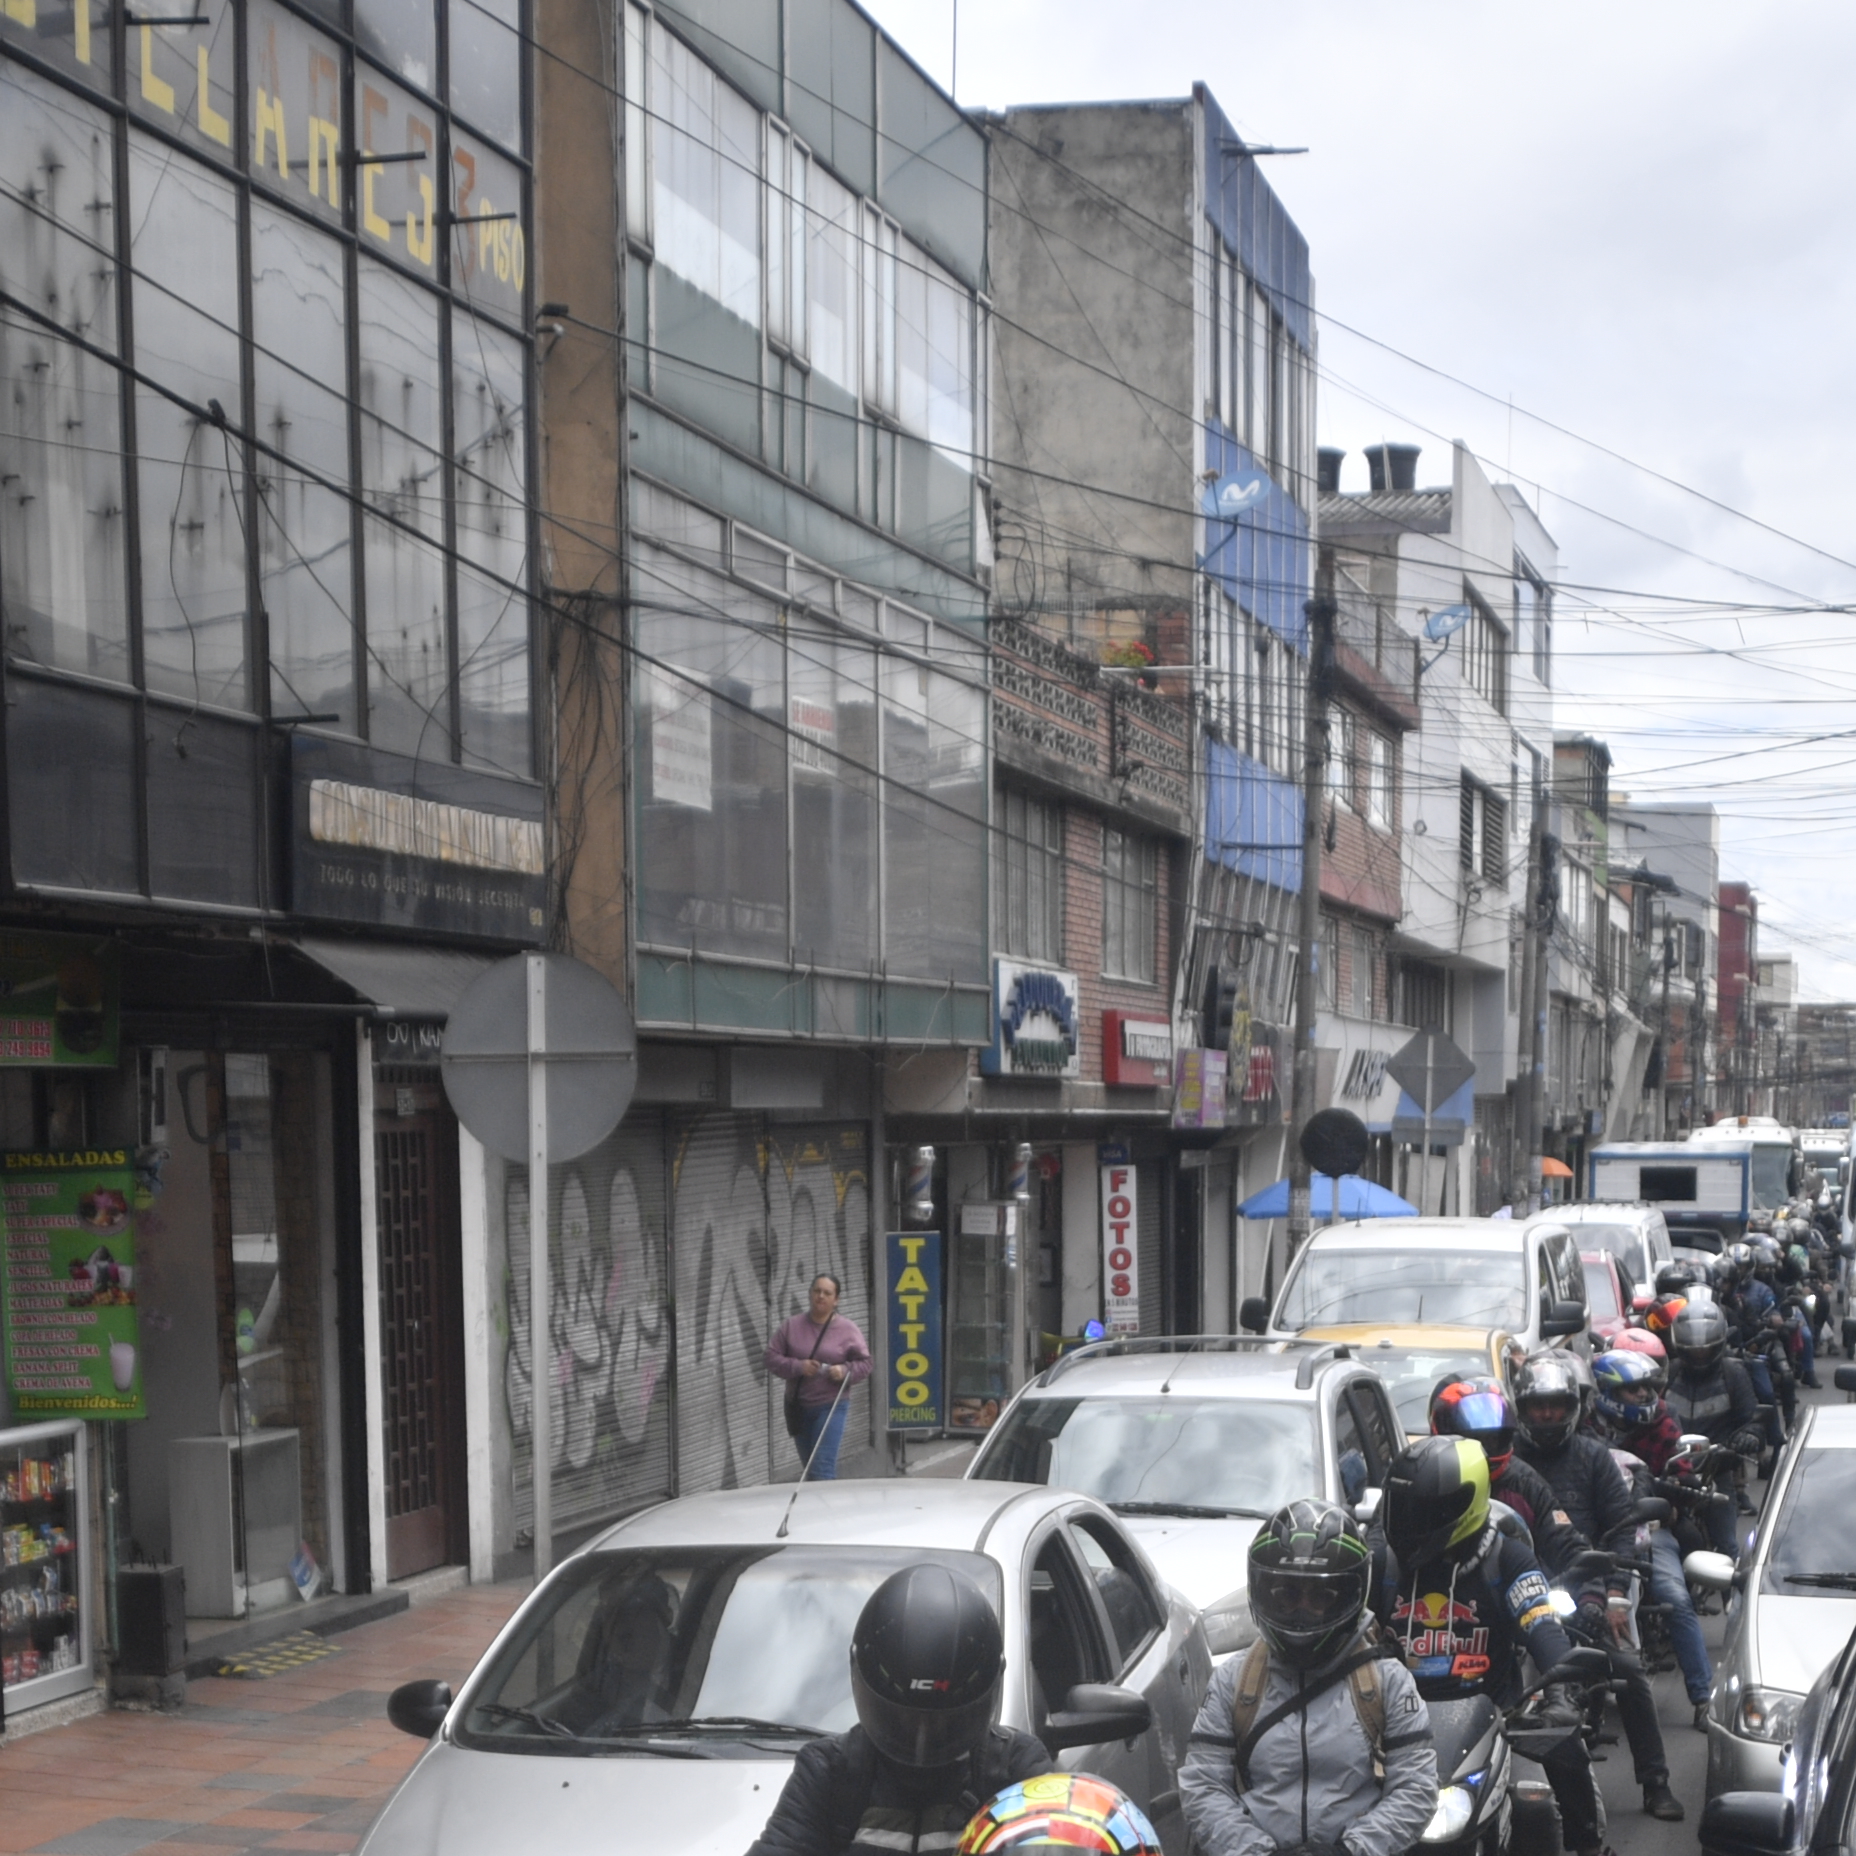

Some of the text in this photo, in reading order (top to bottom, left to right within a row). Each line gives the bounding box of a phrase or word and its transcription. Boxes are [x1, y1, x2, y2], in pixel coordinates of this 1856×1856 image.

[478, 196, 526, 294] PISO
[319, 863, 355, 886] TODO
[360, 868, 378, 889] LO
[383, 872, 407, 894] QUE
[412, 877, 429, 898] SU
[5, 1149, 127, 1169] ENSALADAS
[1107, 1168, 1133, 1298] FOTOS
[6, 1247, 51, 1262] NATURAL
[7, 1278, 95, 1294] JUGOS NATURALES
[8, 1296, 65, 1310] MALTEADAS
[895, 1237, 931, 1406] TATTOO
[11, 1343, 100, 1359] FRESAS CON CREMA
[12, 1361, 51, 1375] BANANA
[13, 1375, 92, 1391] CREMA DE AVENA
[889, 1407, 937, 1425] PIERCING
[1278, 1556, 1330, 1566] LS2
[1435, 1627, 1490, 1656] Bull
